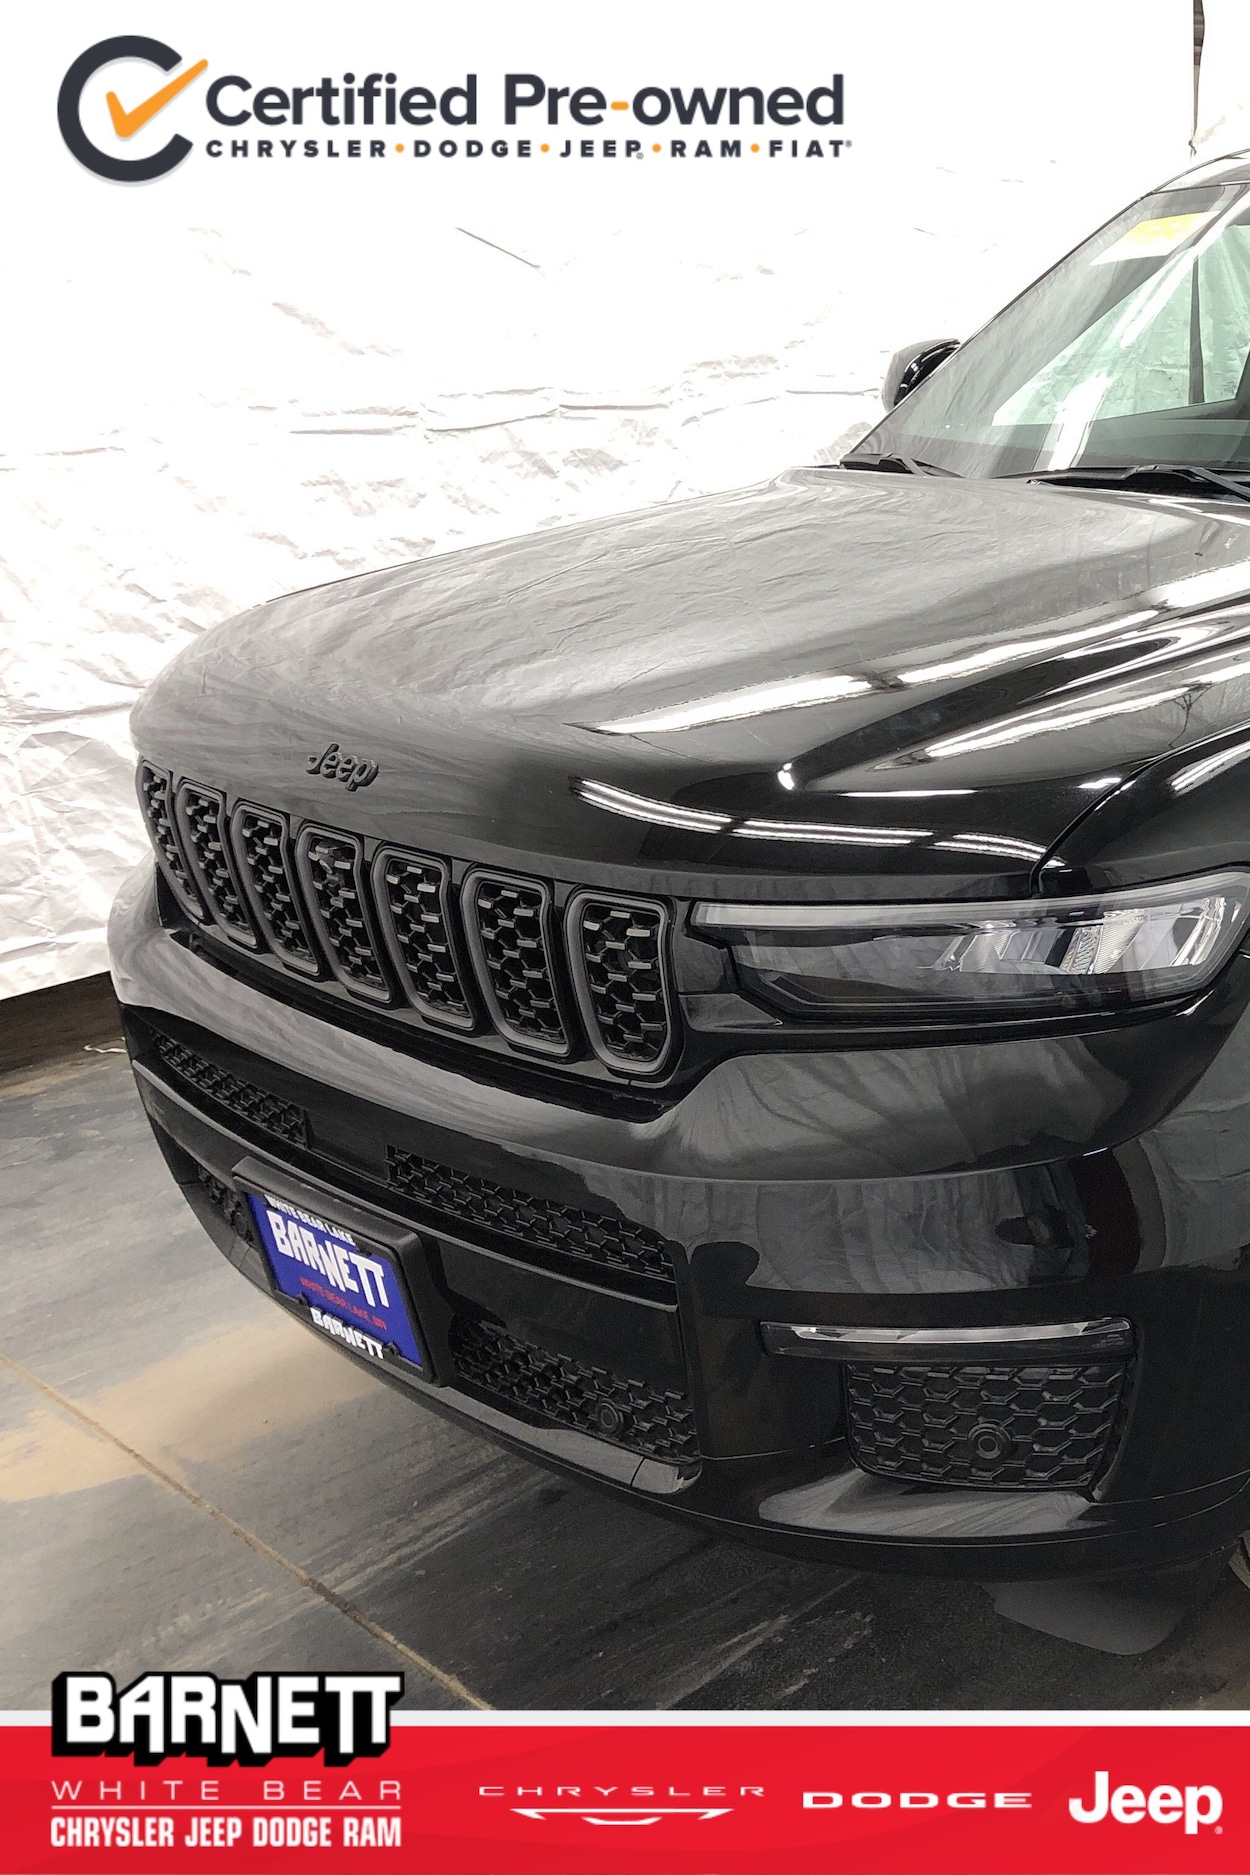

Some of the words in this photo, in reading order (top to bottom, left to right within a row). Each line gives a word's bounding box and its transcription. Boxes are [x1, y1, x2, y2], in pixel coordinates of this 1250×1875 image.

[305, 742, 379, 792] Jeep
[266, 1210, 390, 1308] BARNETT
[324, 1223, 357, 1247] LAKE
[310, 1307, 384, 1360] BARNETT
